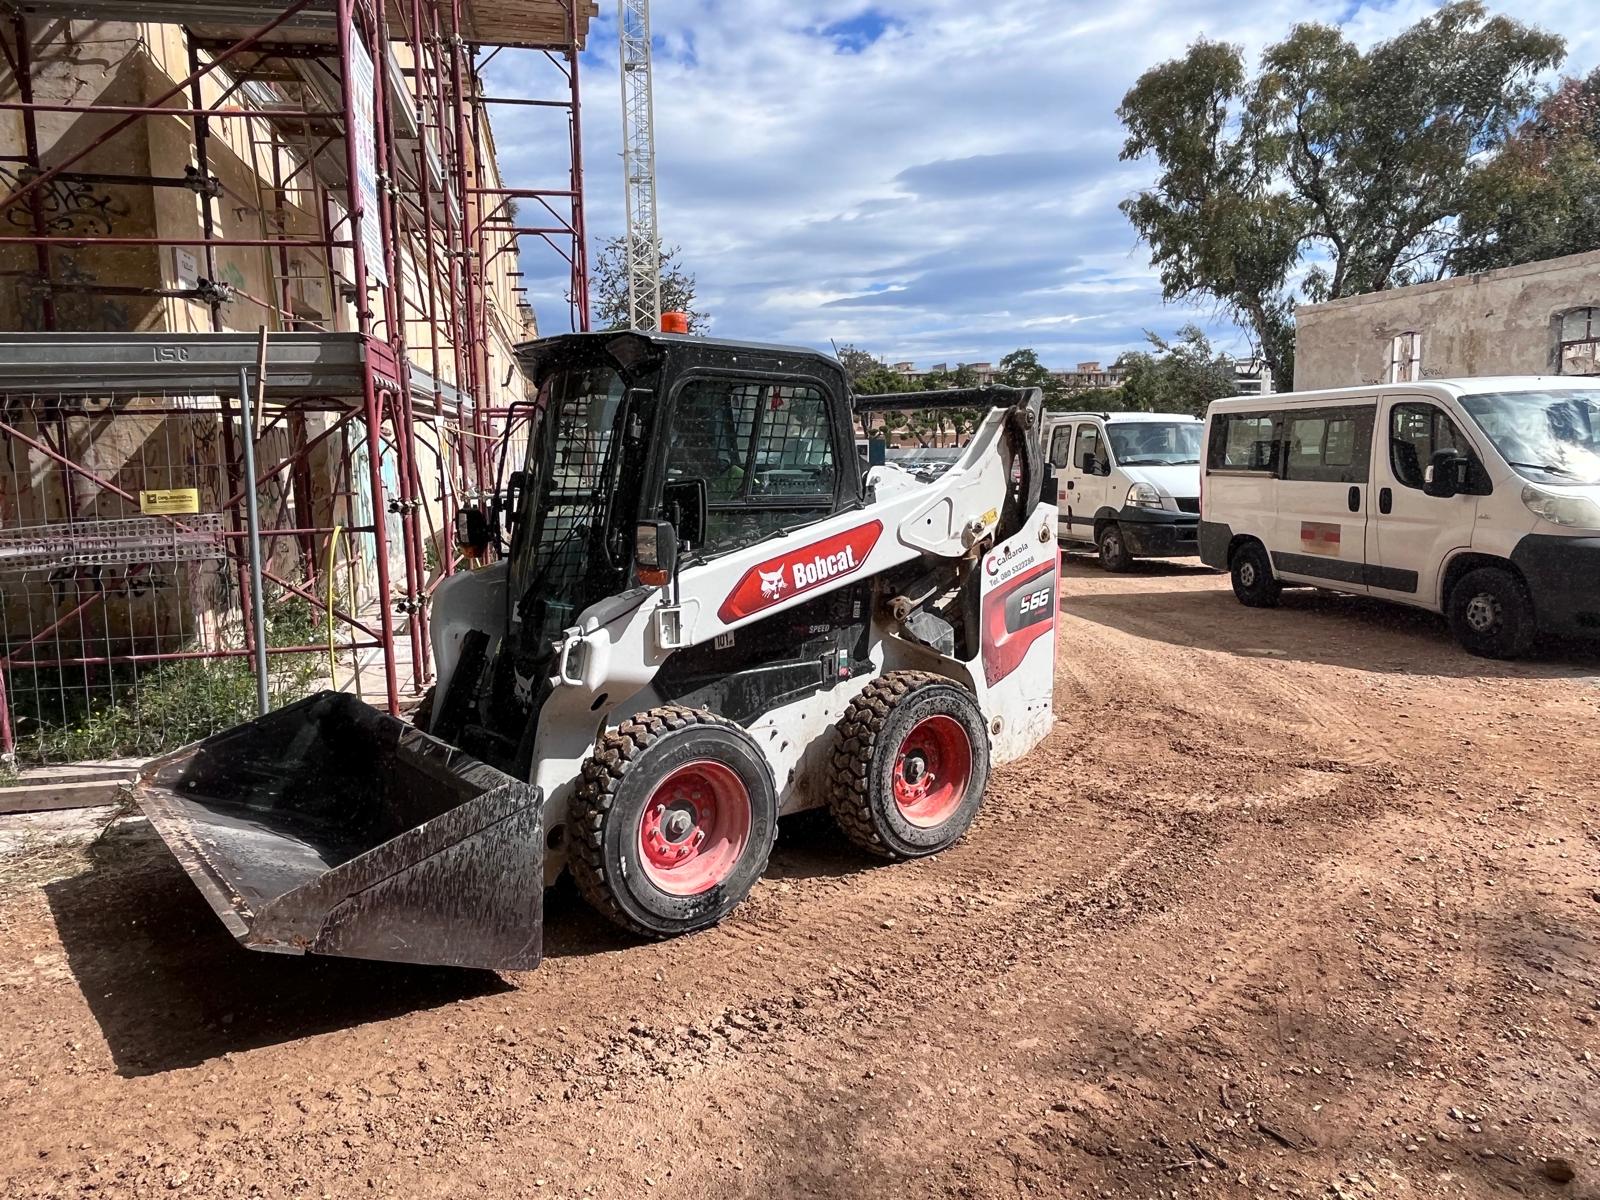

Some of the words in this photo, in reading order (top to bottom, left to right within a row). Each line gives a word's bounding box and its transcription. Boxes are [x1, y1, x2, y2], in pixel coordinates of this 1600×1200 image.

[792, 544, 855, 589] Bobcat
[997, 543, 1029, 566] Caldarola
[1020, 587, 1050, 614] S66
[809, 624, 830, 634] SPEED
